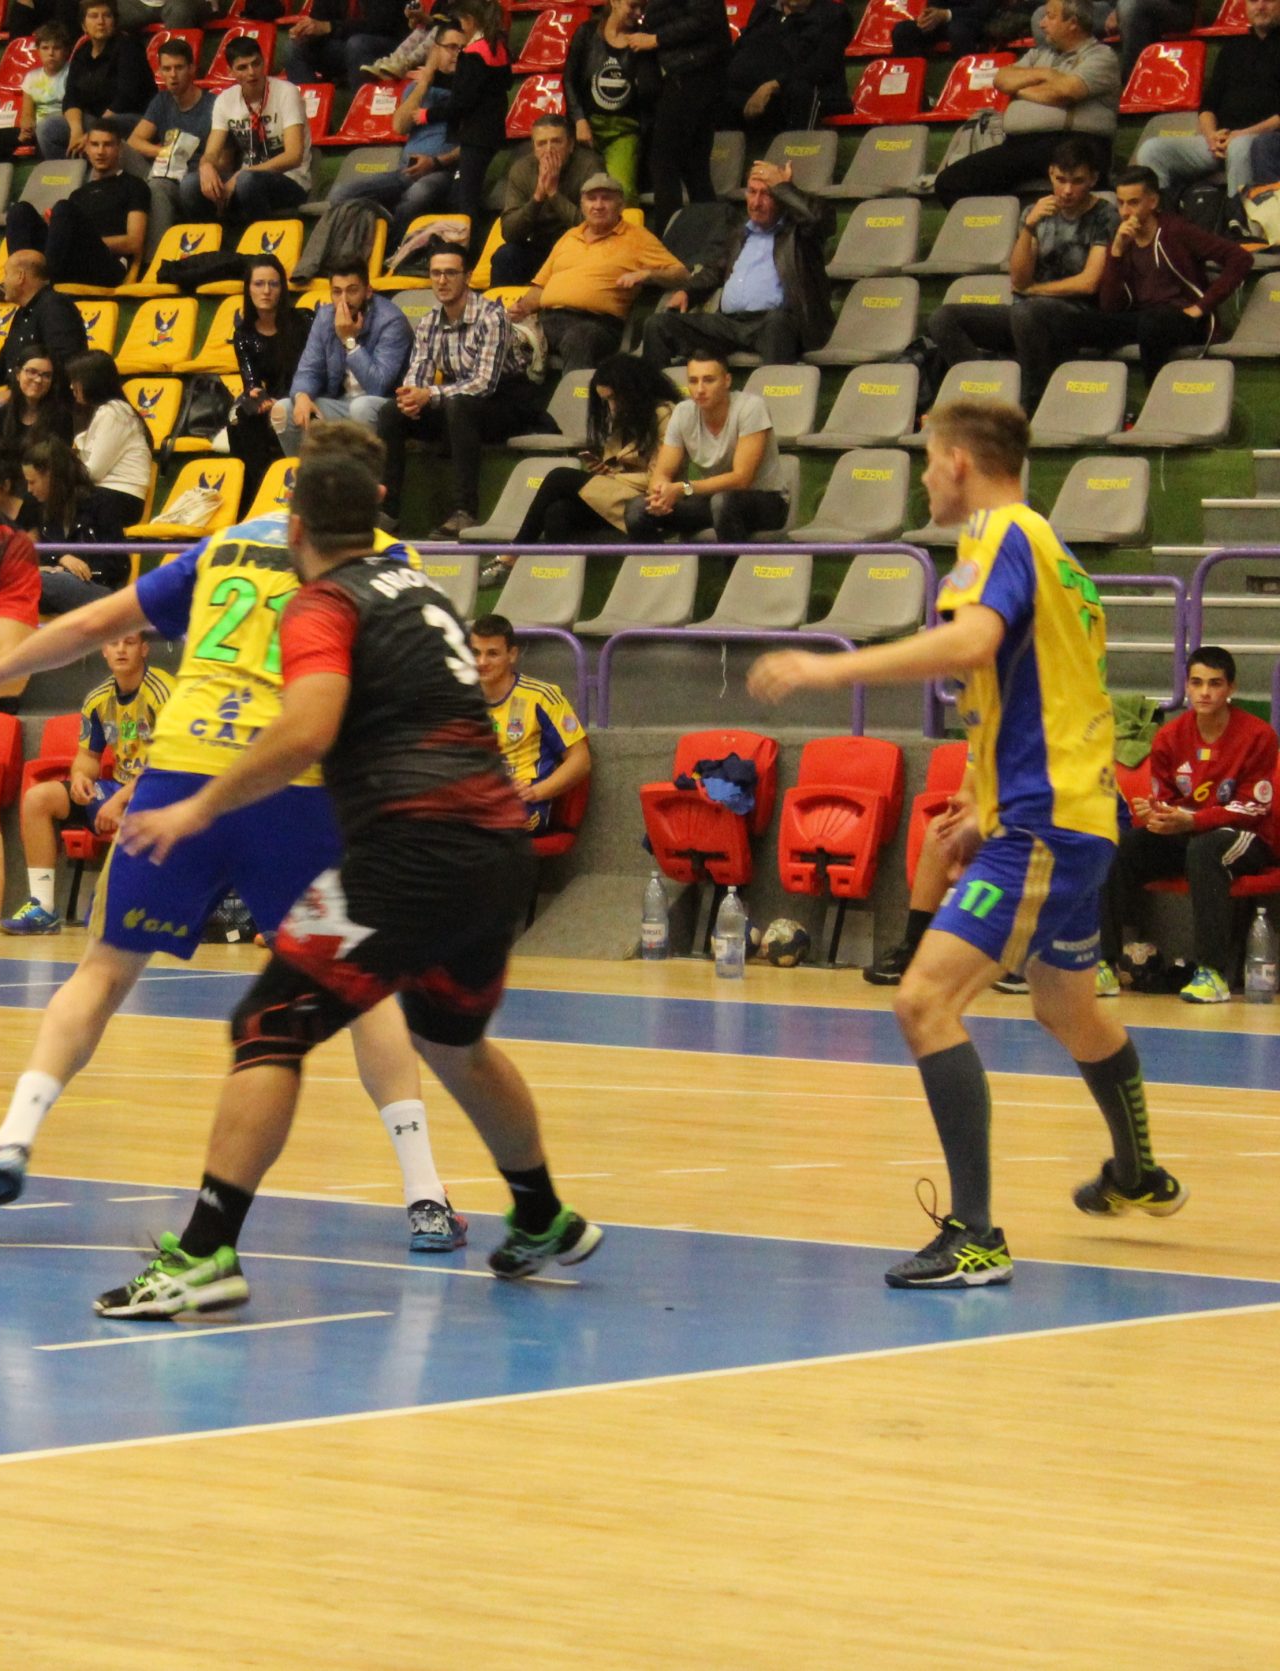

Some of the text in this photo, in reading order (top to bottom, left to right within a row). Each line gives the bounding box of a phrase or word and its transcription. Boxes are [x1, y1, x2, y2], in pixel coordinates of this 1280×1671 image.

[784, 144, 821, 157] REZERVAT
[875, 138, 913, 151] REZERVAT
[864, 215, 906, 229] REZERVAT
[963, 214, 1004, 228] REZERVAT
[862, 296, 904, 309] REZERVAT
[762, 384, 805, 397] REZERVAT
[858, 382, 901, 396] REZERVAT
[959, 380, 1004, 394] REZERVAT
[1066, 380, 1110, 394] REZERVAT
[1172, 381, 1216, 395] REZERVAT
[851, 468, 895, 481] REZERVAT
[1086, 476, 1132, 491] REZERVAT
[530, 565, 570, 580] REZERVAT
[639, 563, 681, 578] REZERVAT
[752, 565, 795, 579] REZERVAT
[867, 566, 910, 580] REZERVAT
[1193, 780, 1214, 802] 6
[959, 879, 1005, 919] 17
